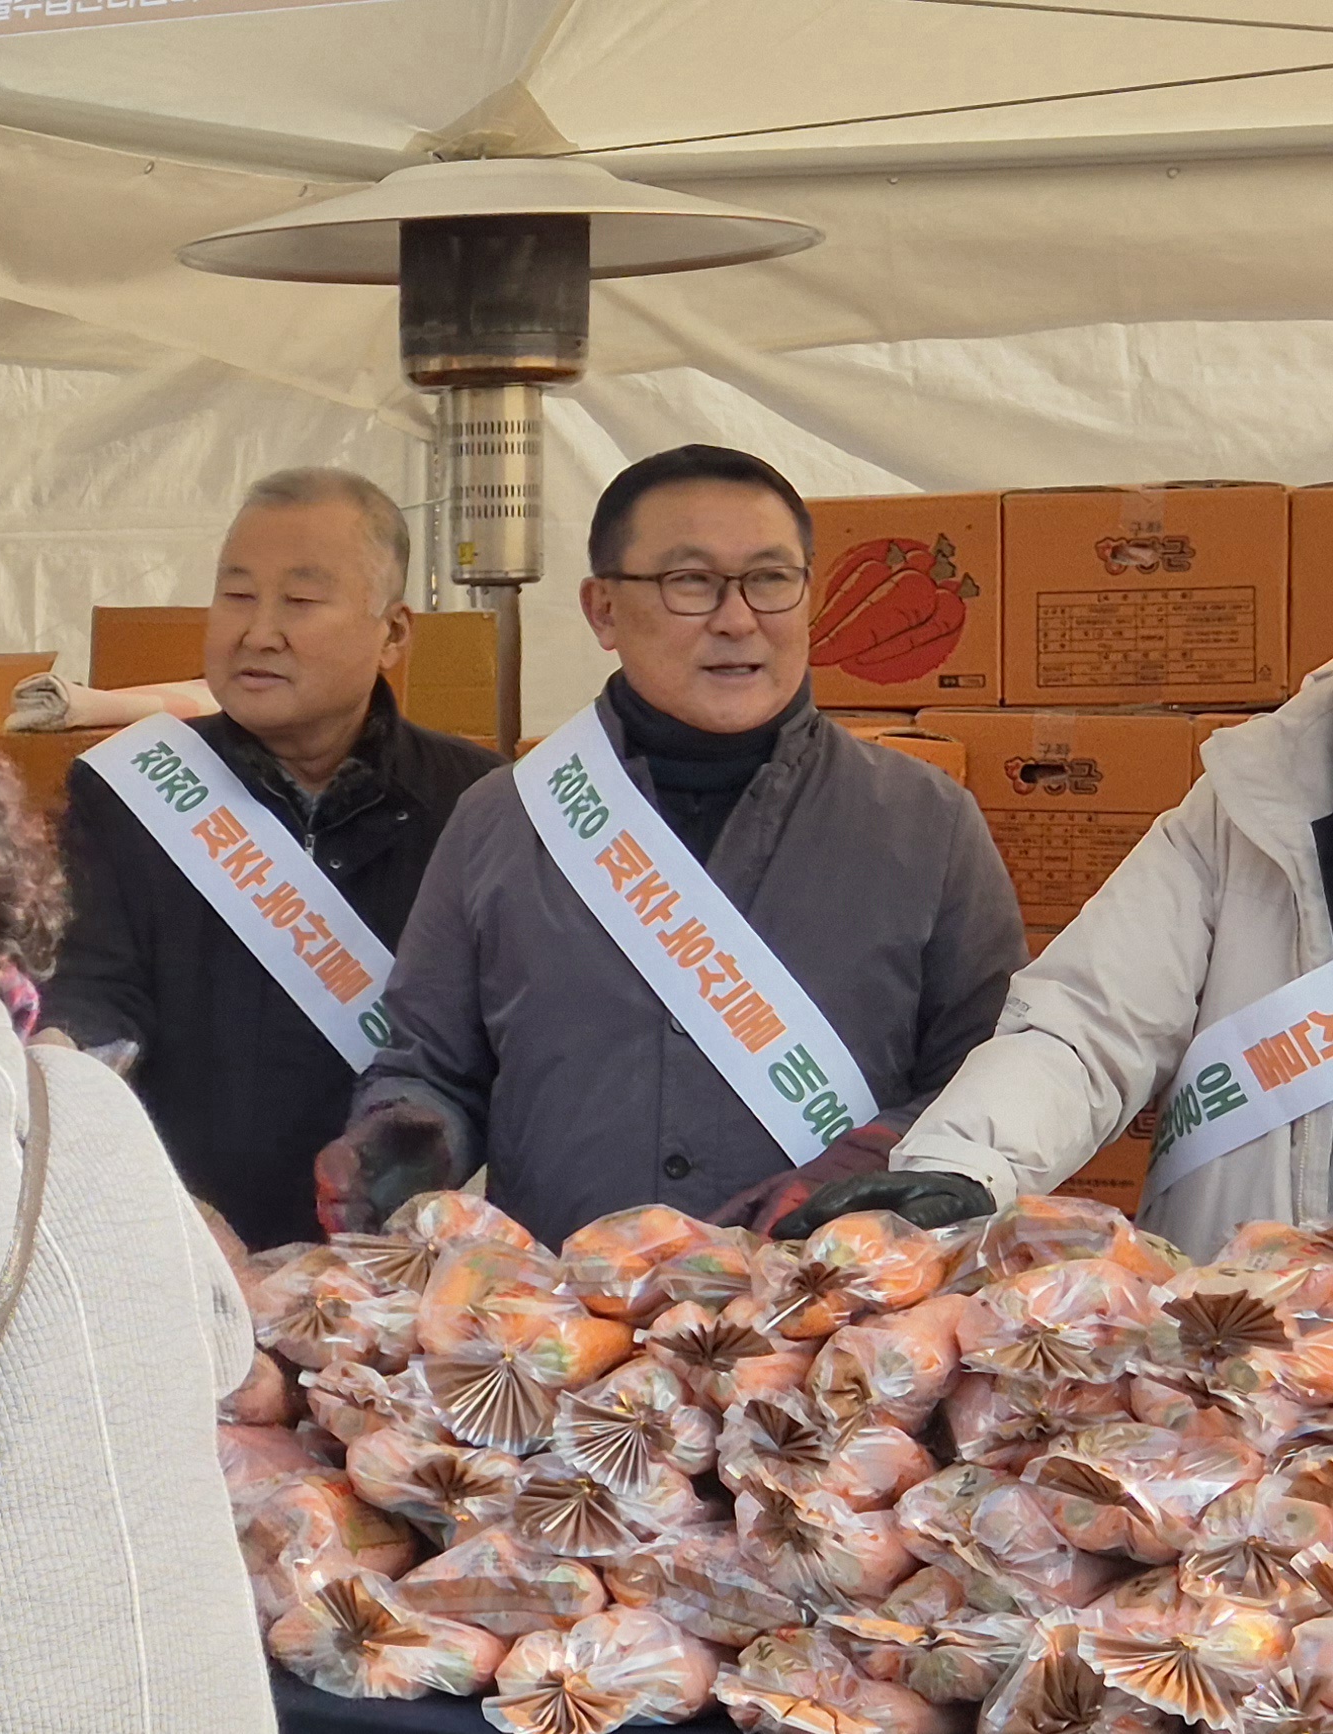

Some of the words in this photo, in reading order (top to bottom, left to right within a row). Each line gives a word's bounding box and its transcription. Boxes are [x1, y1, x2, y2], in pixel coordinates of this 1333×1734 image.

[130, 741, 210, 814] 청정
[190, 804, 373, 1006] 제주농산물
[546, 753, 611, 840] 청정
[594, 829, 787, 1055] 제주농산물
